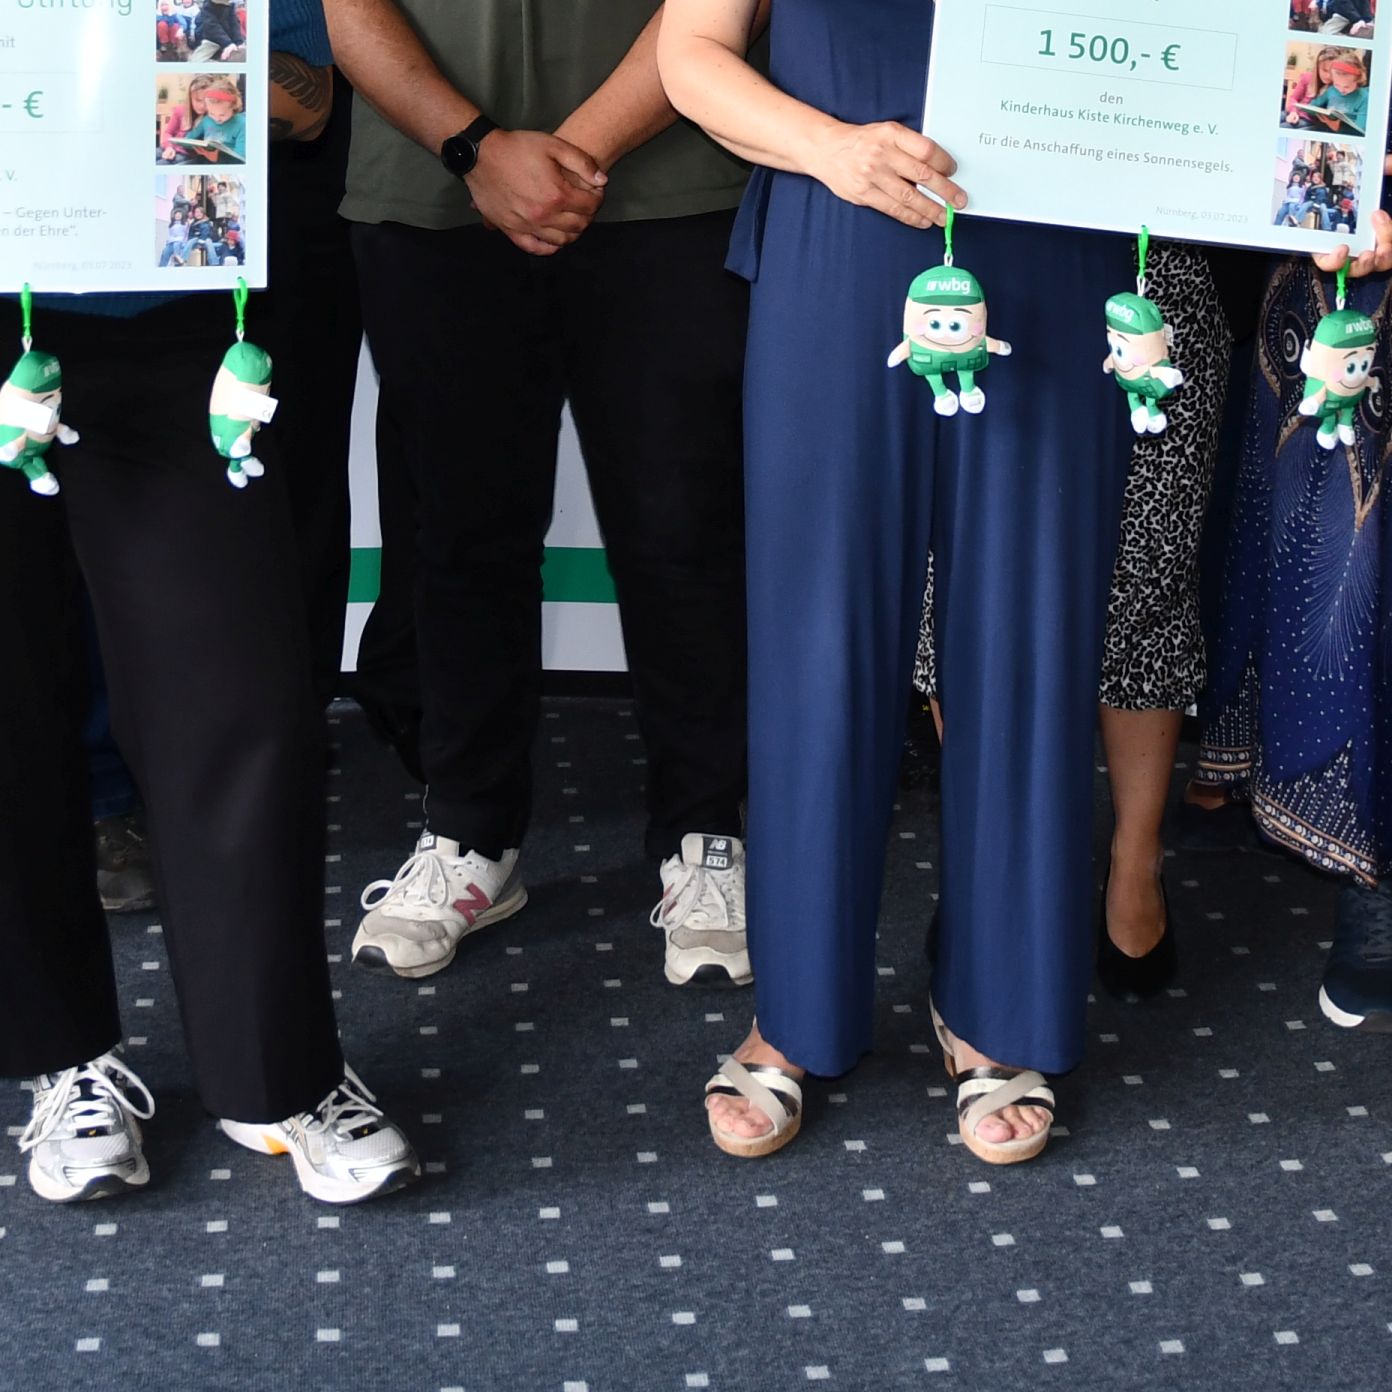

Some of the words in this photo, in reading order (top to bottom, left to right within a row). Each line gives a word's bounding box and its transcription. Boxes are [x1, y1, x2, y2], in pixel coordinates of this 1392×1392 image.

[1039, 30, 1055, 56] 1
[1069, 33, 1150, 71] 500,-
[1161, 44, 1181, 70] €
[24, 91, 43, 118] €
[1100, 92, 1123, 104] den
[1001, 100, 1073, 118] Kinderhaus
[1078, 109, 1109, 123] Kiste
[1114, 113, 1189, 135] Kirchenweg
[1193, 125, 1203, 133] e.
[1208, 124, 1218, 135] V.
[979, 133, 997, 144] für
[1001, 136, 1020, 148] die
[1024, 139, 1103, 161] Anschaffung
[1107, 149, 1139, 161] eines
[1144, 152, 1232, 173] Sonnensegels.
